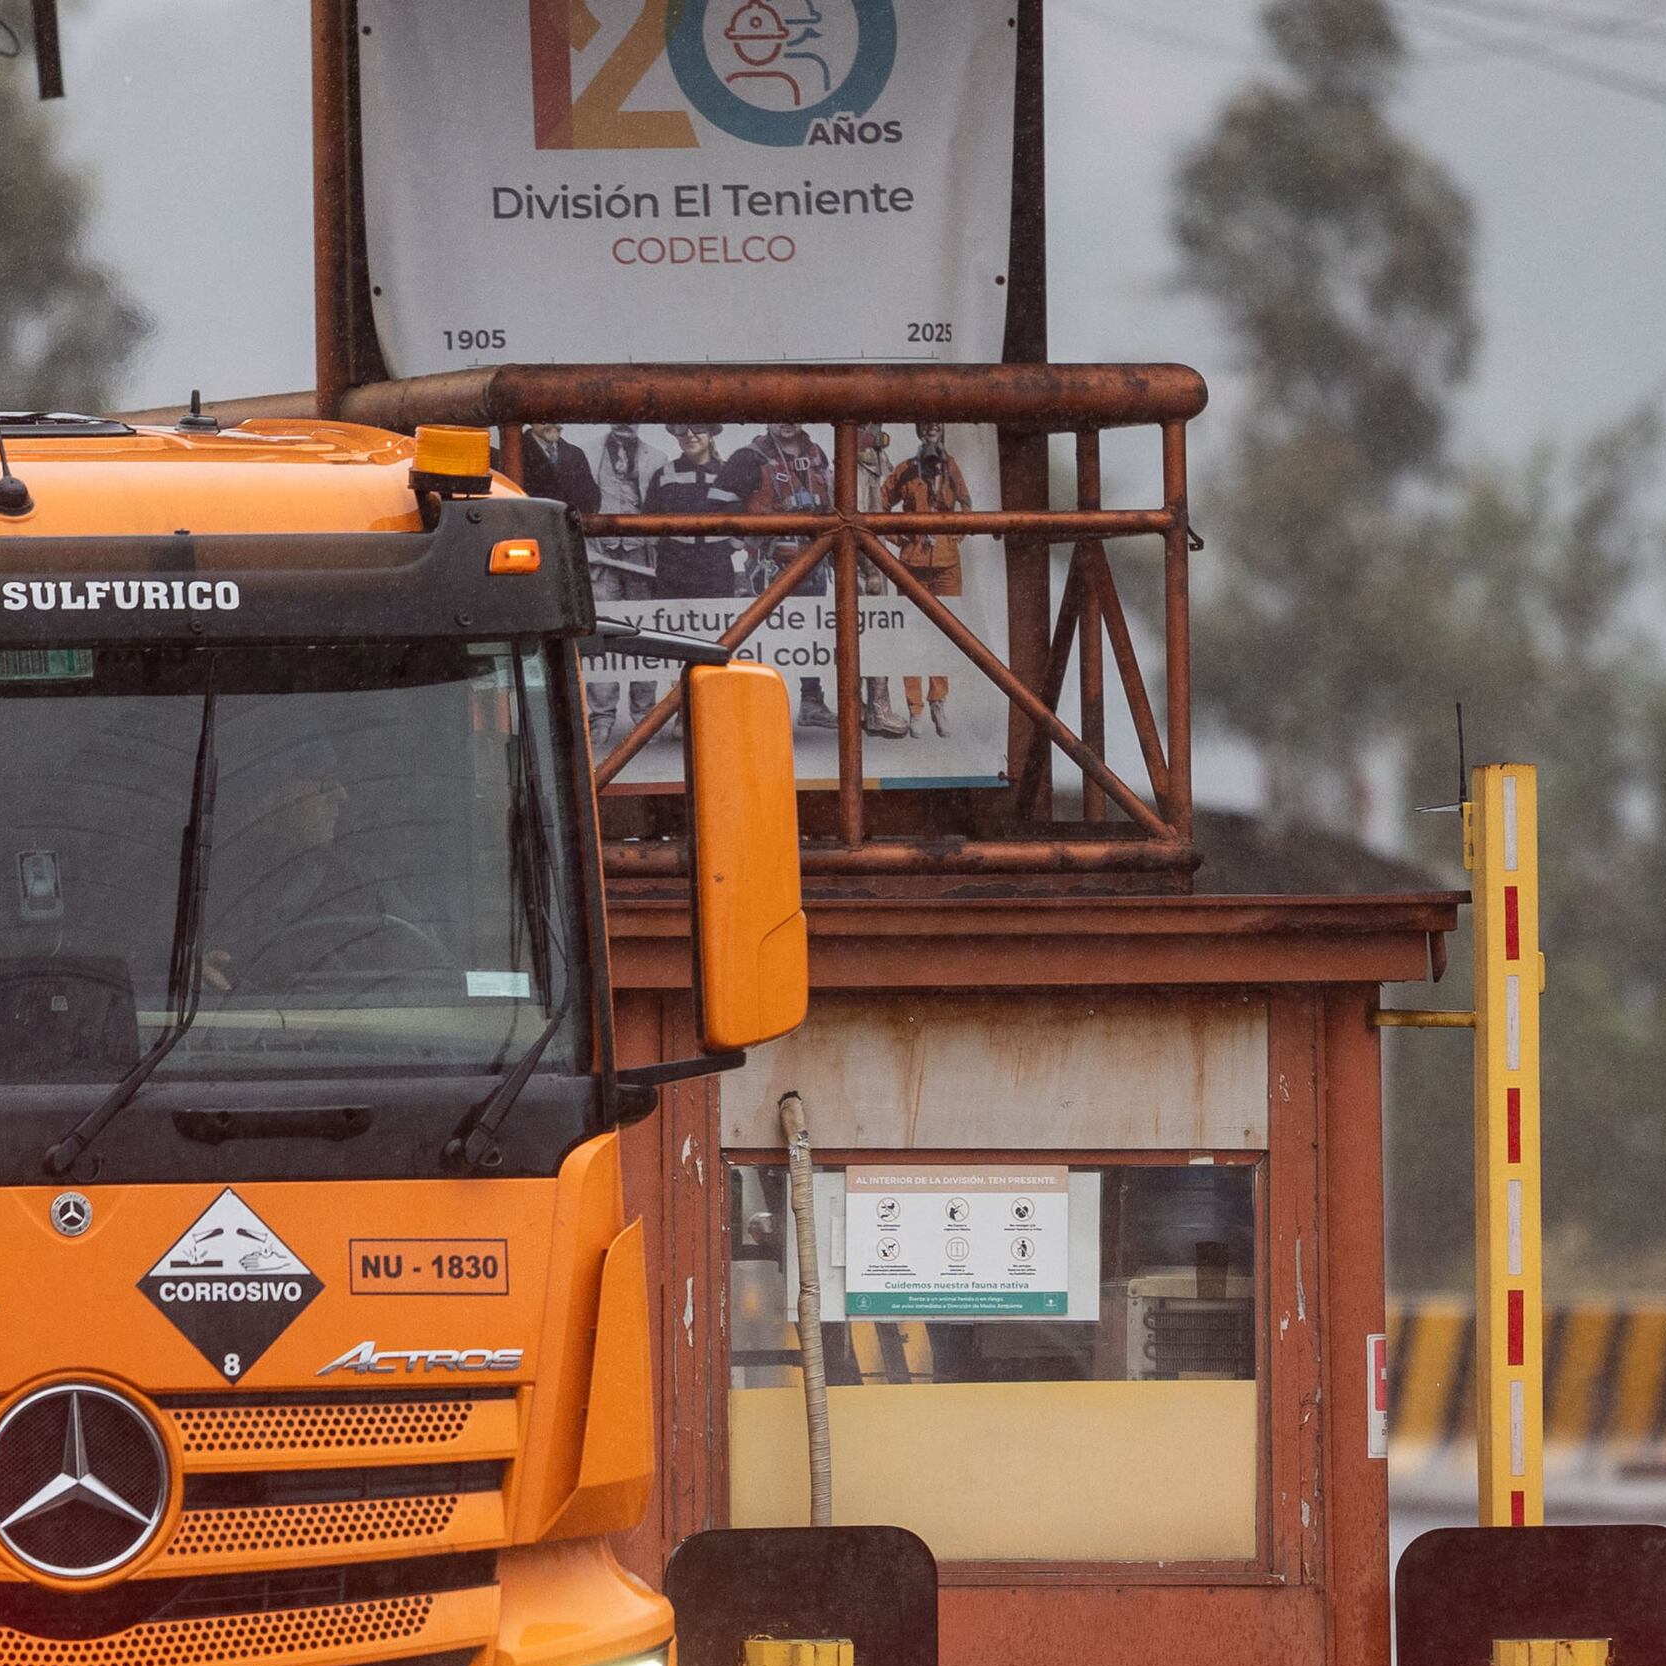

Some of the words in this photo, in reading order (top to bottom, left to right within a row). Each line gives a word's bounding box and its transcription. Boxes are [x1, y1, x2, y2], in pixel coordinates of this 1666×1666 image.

[807, 116, 903, 146] AÑOS
[492, 181, 660, 219] División
[674, 183, 711, 217] El
[721, 180, 915, 217] Teniente
[611, 235, 796, 265] CODELCO
[443, 329, 506, 350] 1905
[907, 322, 952, 343] 2025
[2, 580, 241, 611] SULFURICO
[652, 607, 735, 633] futur
[766, 604, 806, 630] de
[774, 641, 837, 667] cob
[856, 1176, 868, 1185] AL
[869, 1176, 913, 1185] INTERIOR
[915, 1176, 927, 1185] DE
[929, 1176, 942, 1185] LA
[988, 1176, 1006, 1185] TEN
[361, 1254, 403, 1279] NU
[430, 1254, 499, 1279] 1830
[158, 1281, 303, 1303] CORROSIVO
[884, 1281, 932, 1290] Cuidemos
[933, 1281, 969, 1290] nuestra
[972, 1281, 998, 1290] fauna
[1000, 1281, 1030, 1290] nativa
[223, 1352, 241, 1378] 8
